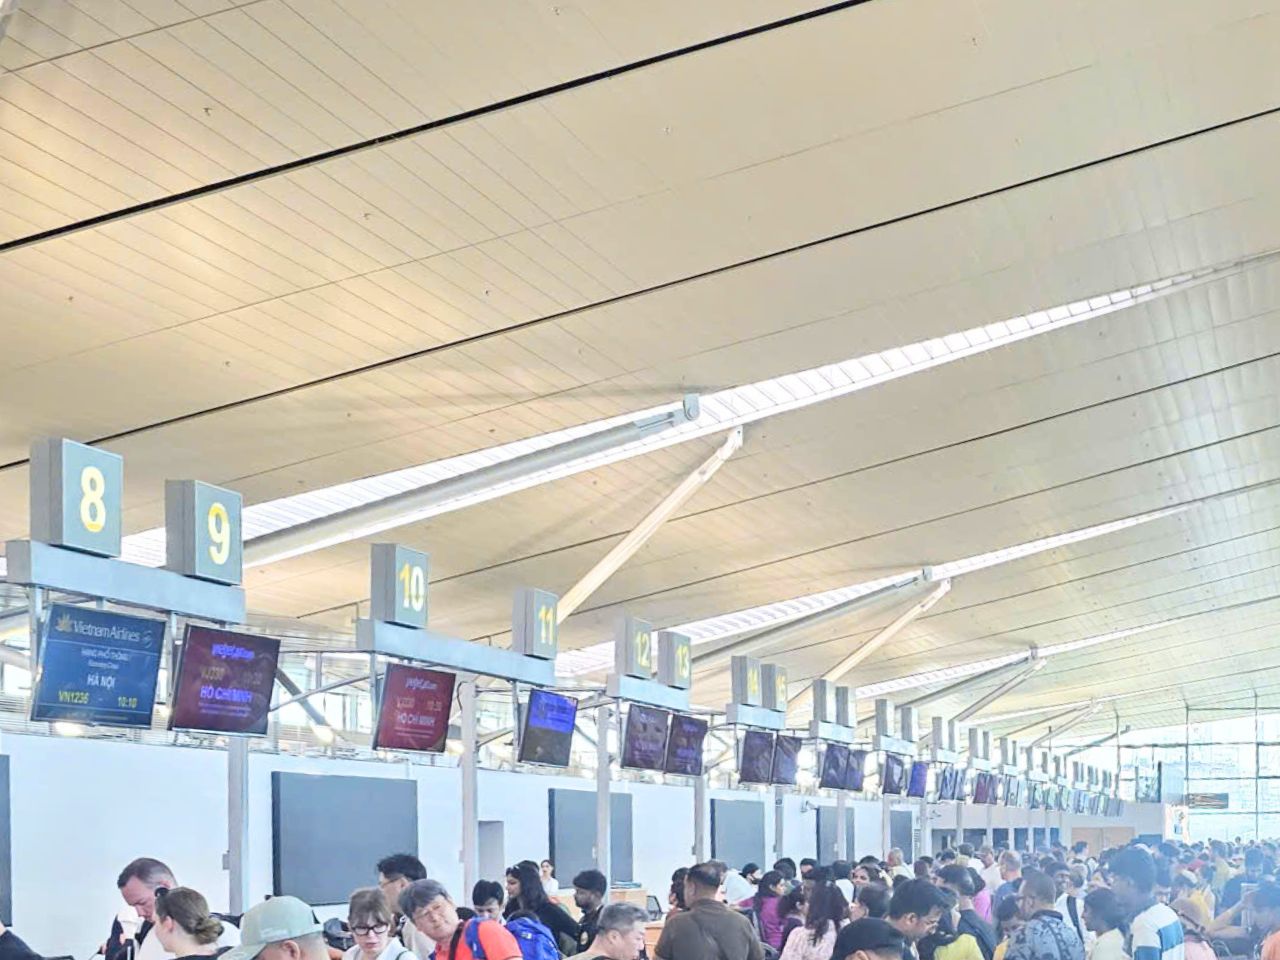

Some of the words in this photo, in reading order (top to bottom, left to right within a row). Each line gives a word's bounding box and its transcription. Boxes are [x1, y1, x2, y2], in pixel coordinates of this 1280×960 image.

[80, 466, 106, 533] 8
[207, 502, 231, 565] 9
[400, 563, 425, 611] 10
[539, 605, 554, 645] 11
[636, 631, 650, 668] 12
[676, 644, 690, 679] 13
